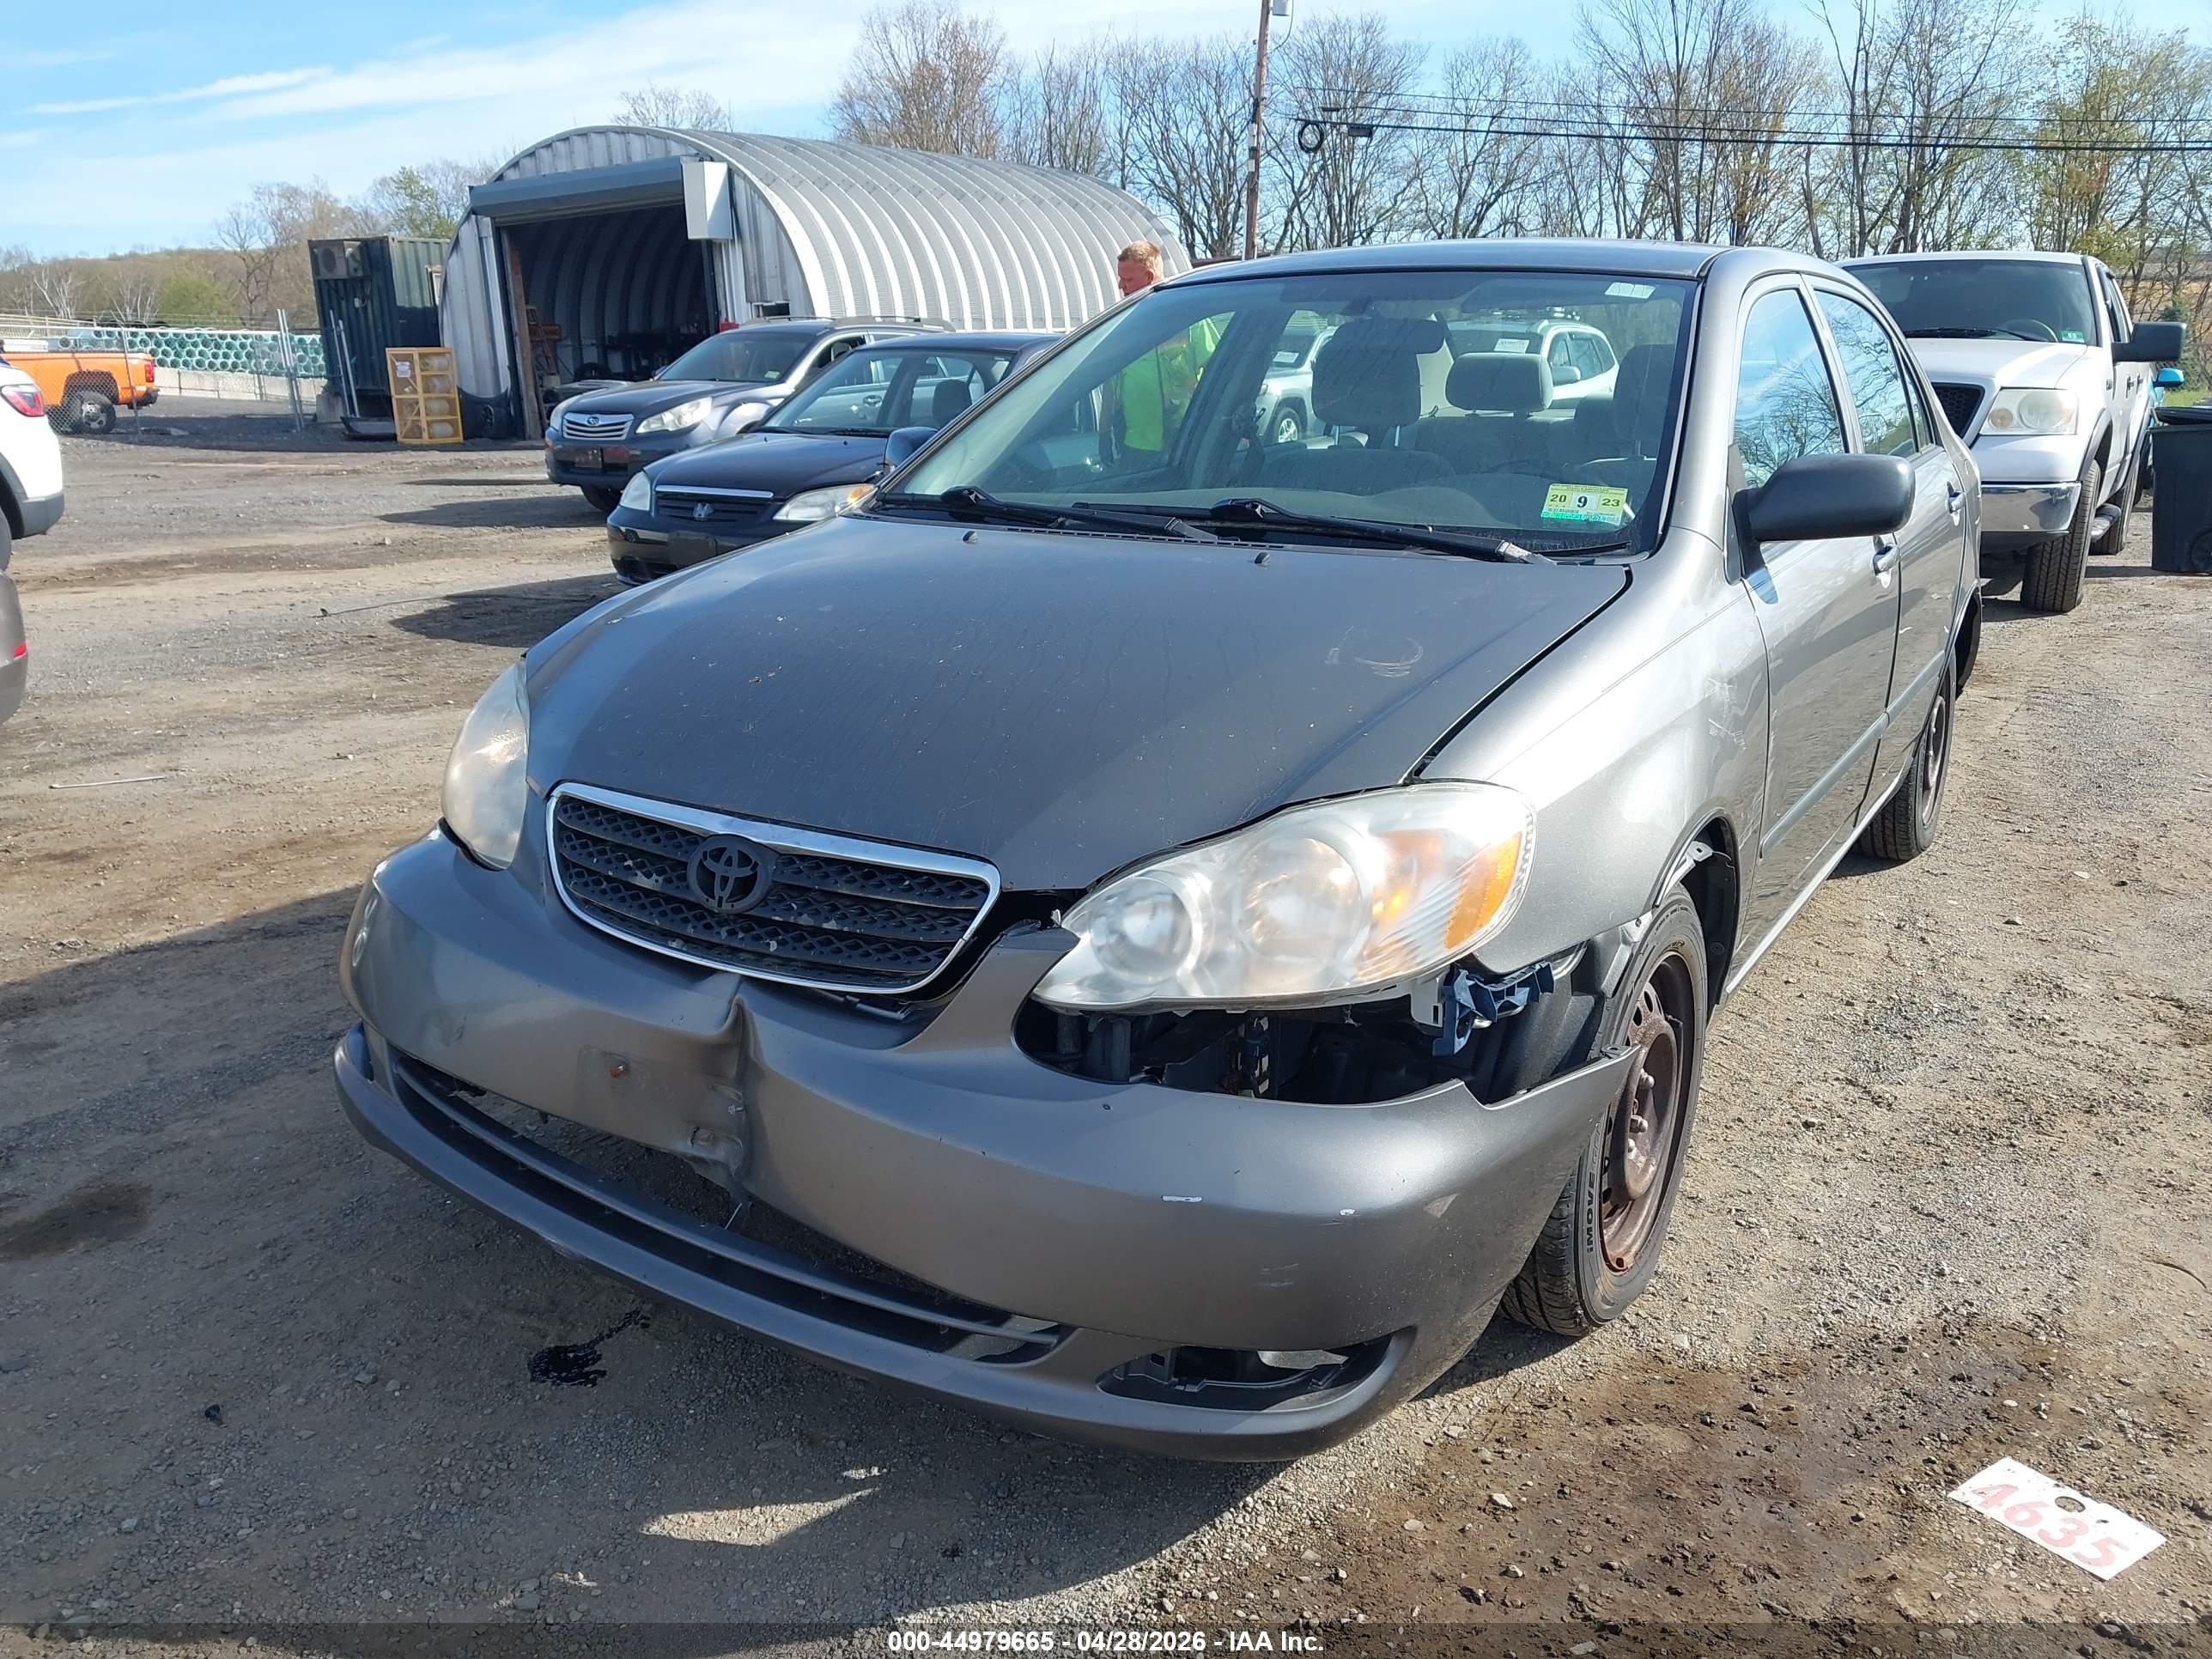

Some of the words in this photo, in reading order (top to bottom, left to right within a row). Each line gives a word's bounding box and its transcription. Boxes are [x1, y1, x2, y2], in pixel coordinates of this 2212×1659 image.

[1549, 494, 1567, 502] 20
[1577, 495, 1588, 508] 9
[1601, 498, 1620, 507] 23
[1972, 1483, 2130, 1567] 4635
